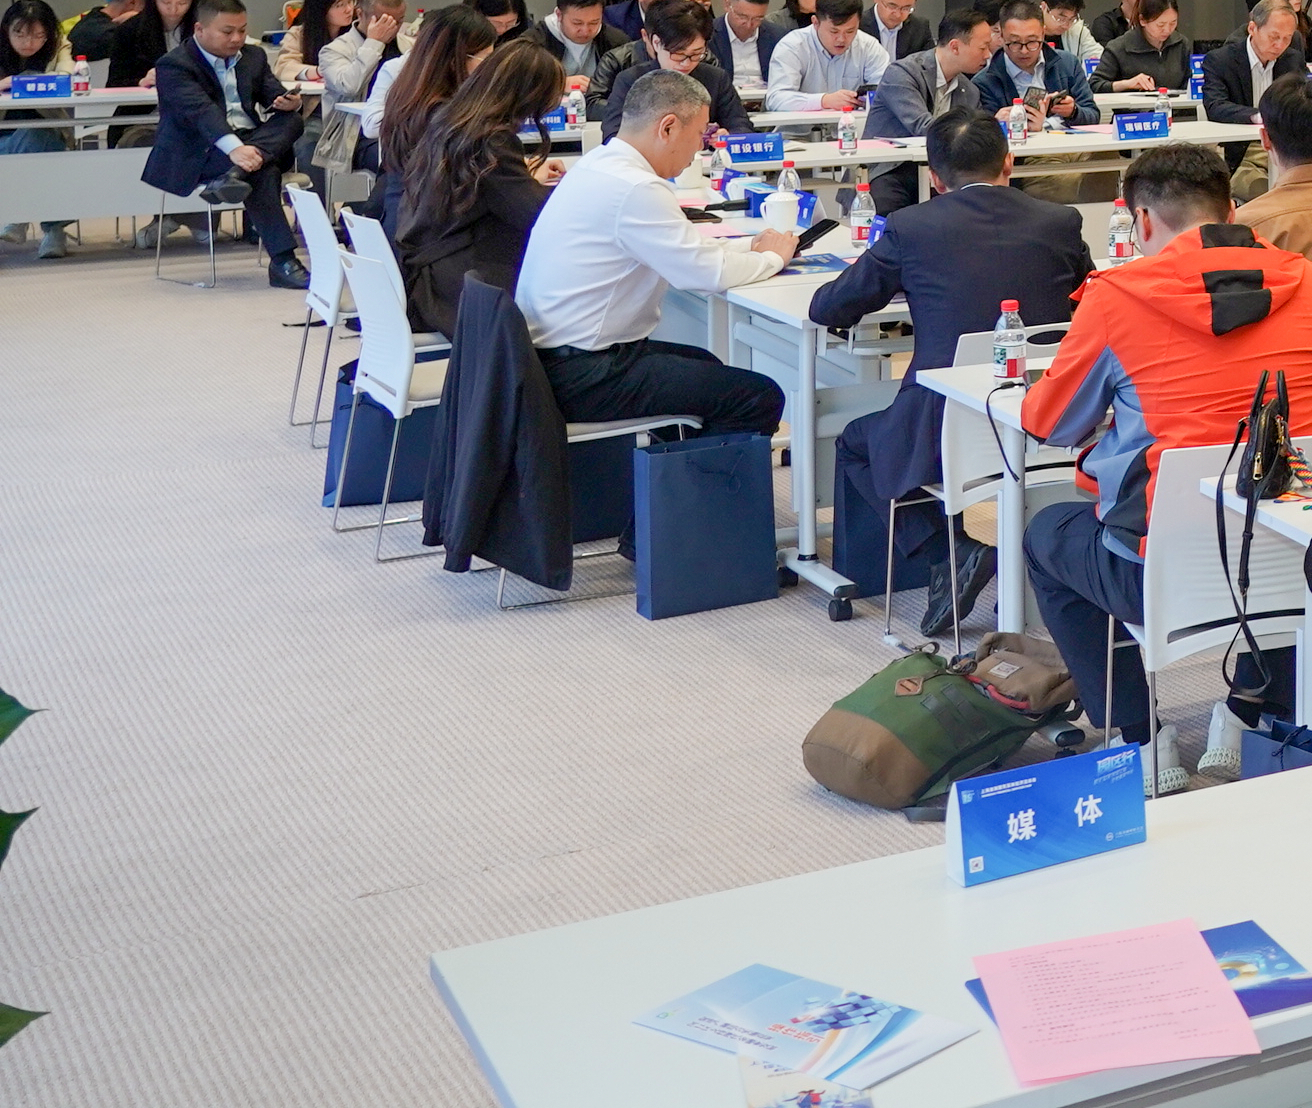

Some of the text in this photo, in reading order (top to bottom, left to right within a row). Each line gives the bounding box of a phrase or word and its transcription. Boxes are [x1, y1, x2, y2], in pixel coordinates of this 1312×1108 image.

[730, 141, 774, 154] 建设银行
[1007, 794, 1103, 843] 媒 体
